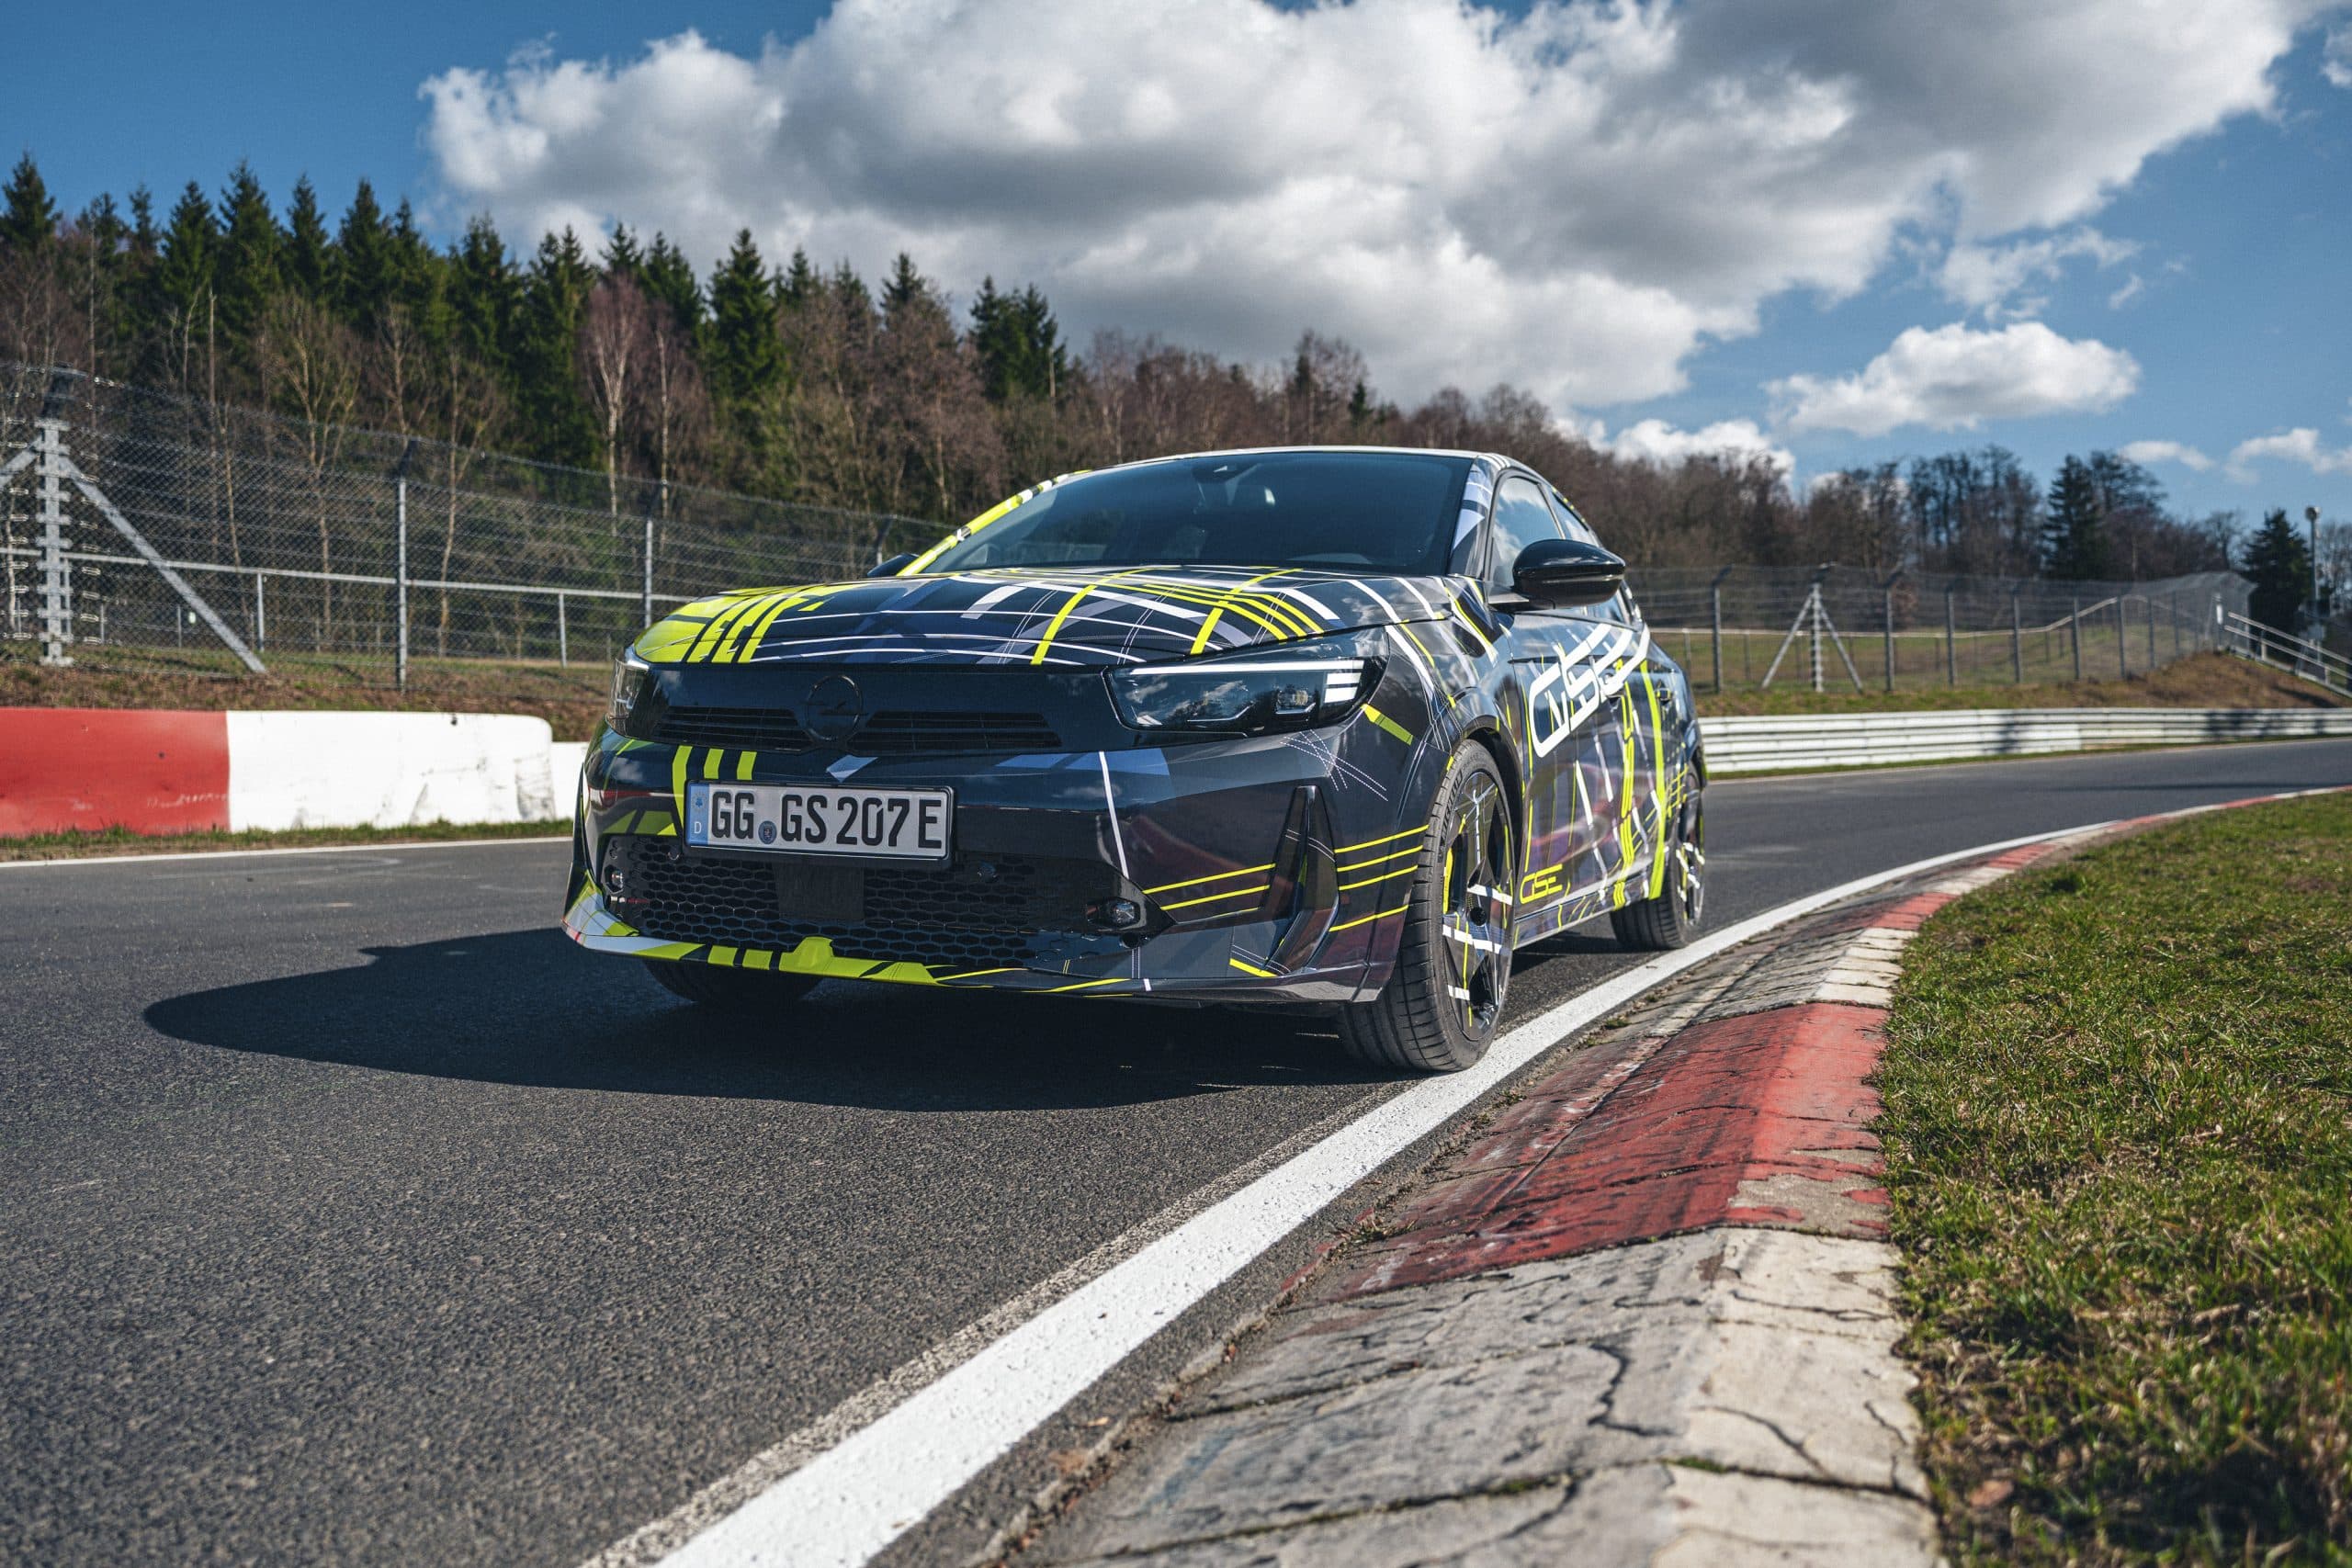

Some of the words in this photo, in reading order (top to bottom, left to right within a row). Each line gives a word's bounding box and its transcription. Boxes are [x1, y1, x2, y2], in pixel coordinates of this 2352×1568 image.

[694, 821, 702, 834] D
[711, 791, 755, 840] GG
[781, 794, 828, 843] GS
[836, 796, 910, 847] 207
[918, 799, 943, 850] E
[1520, 863, 1563, 904] GSE
